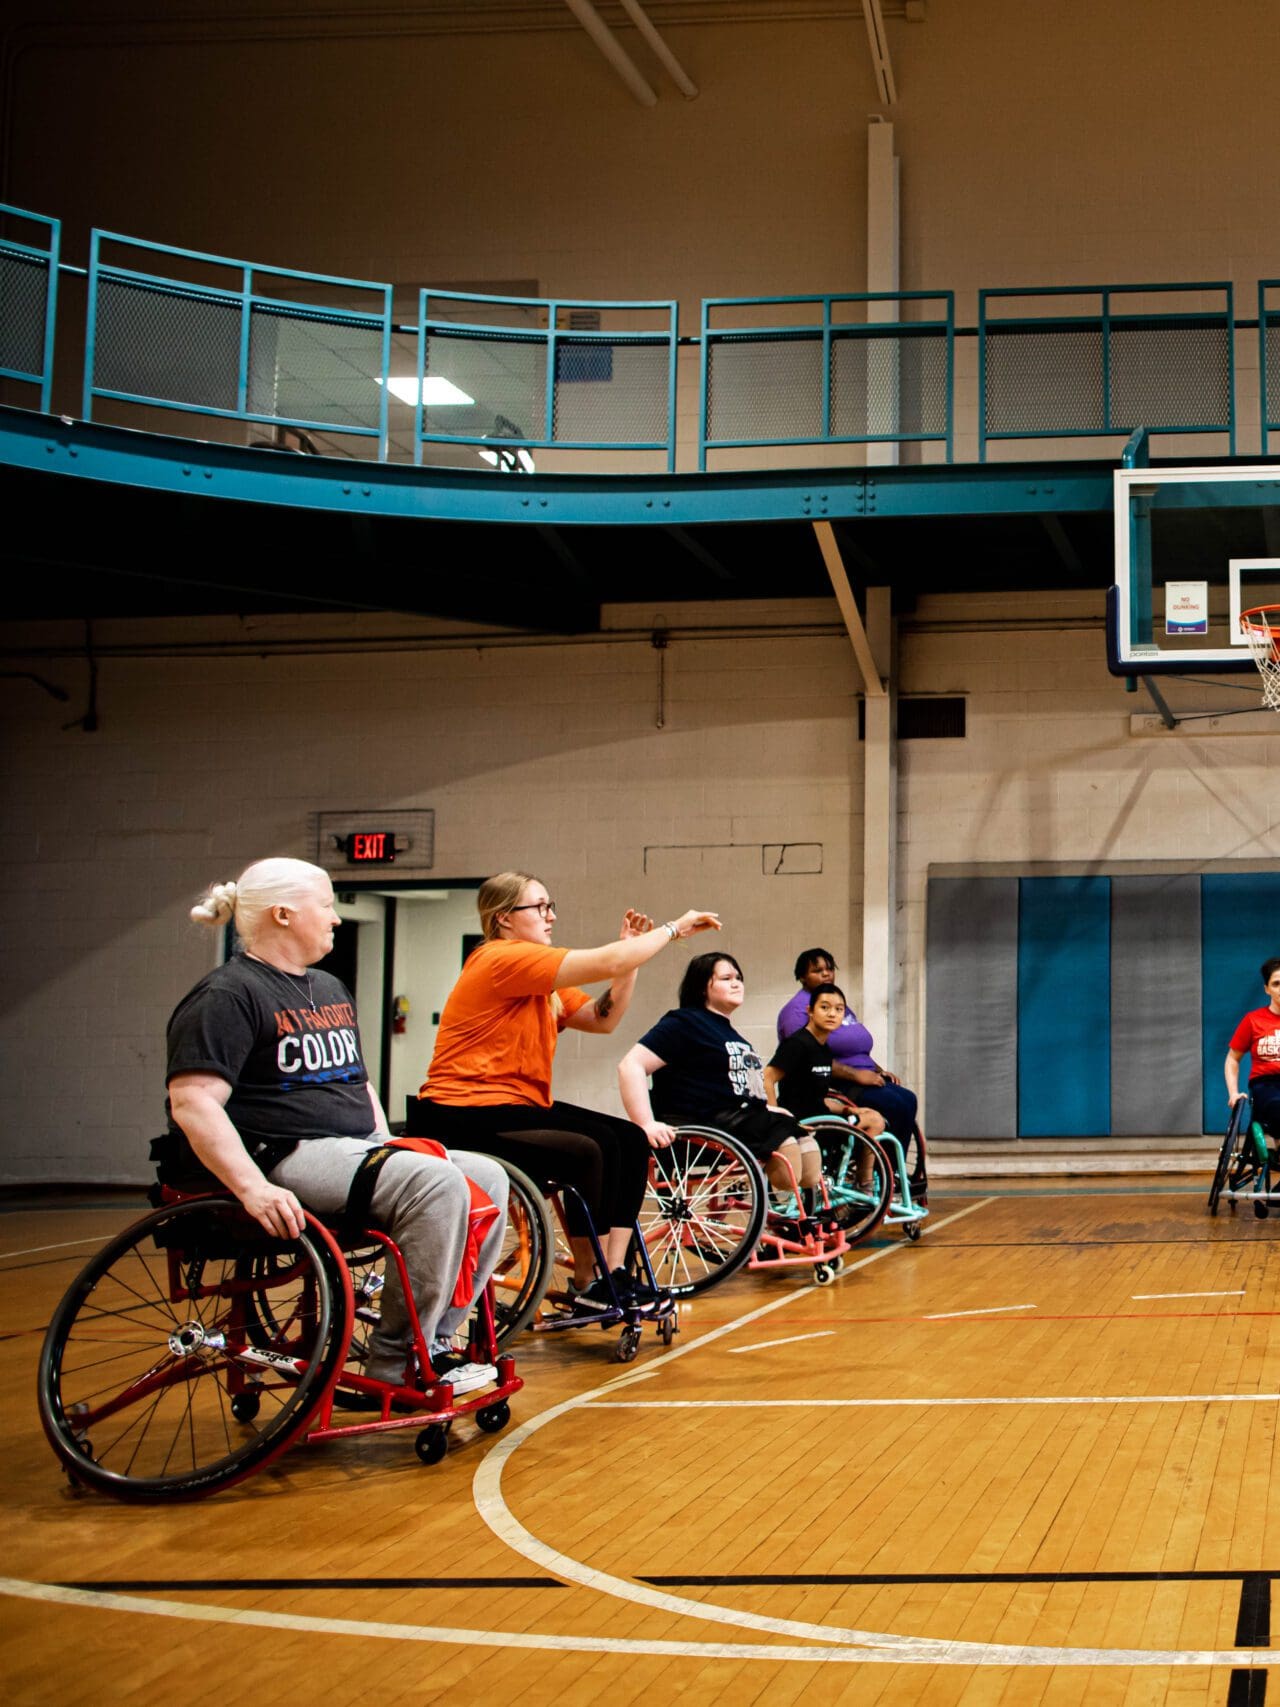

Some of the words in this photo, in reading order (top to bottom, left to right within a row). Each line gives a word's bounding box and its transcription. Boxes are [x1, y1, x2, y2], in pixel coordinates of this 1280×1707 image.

[353, 833, 386, 860] EXIT
[274, 1009, 303, 1037] MY
[277, 1028, 360, 1073] COLOR
